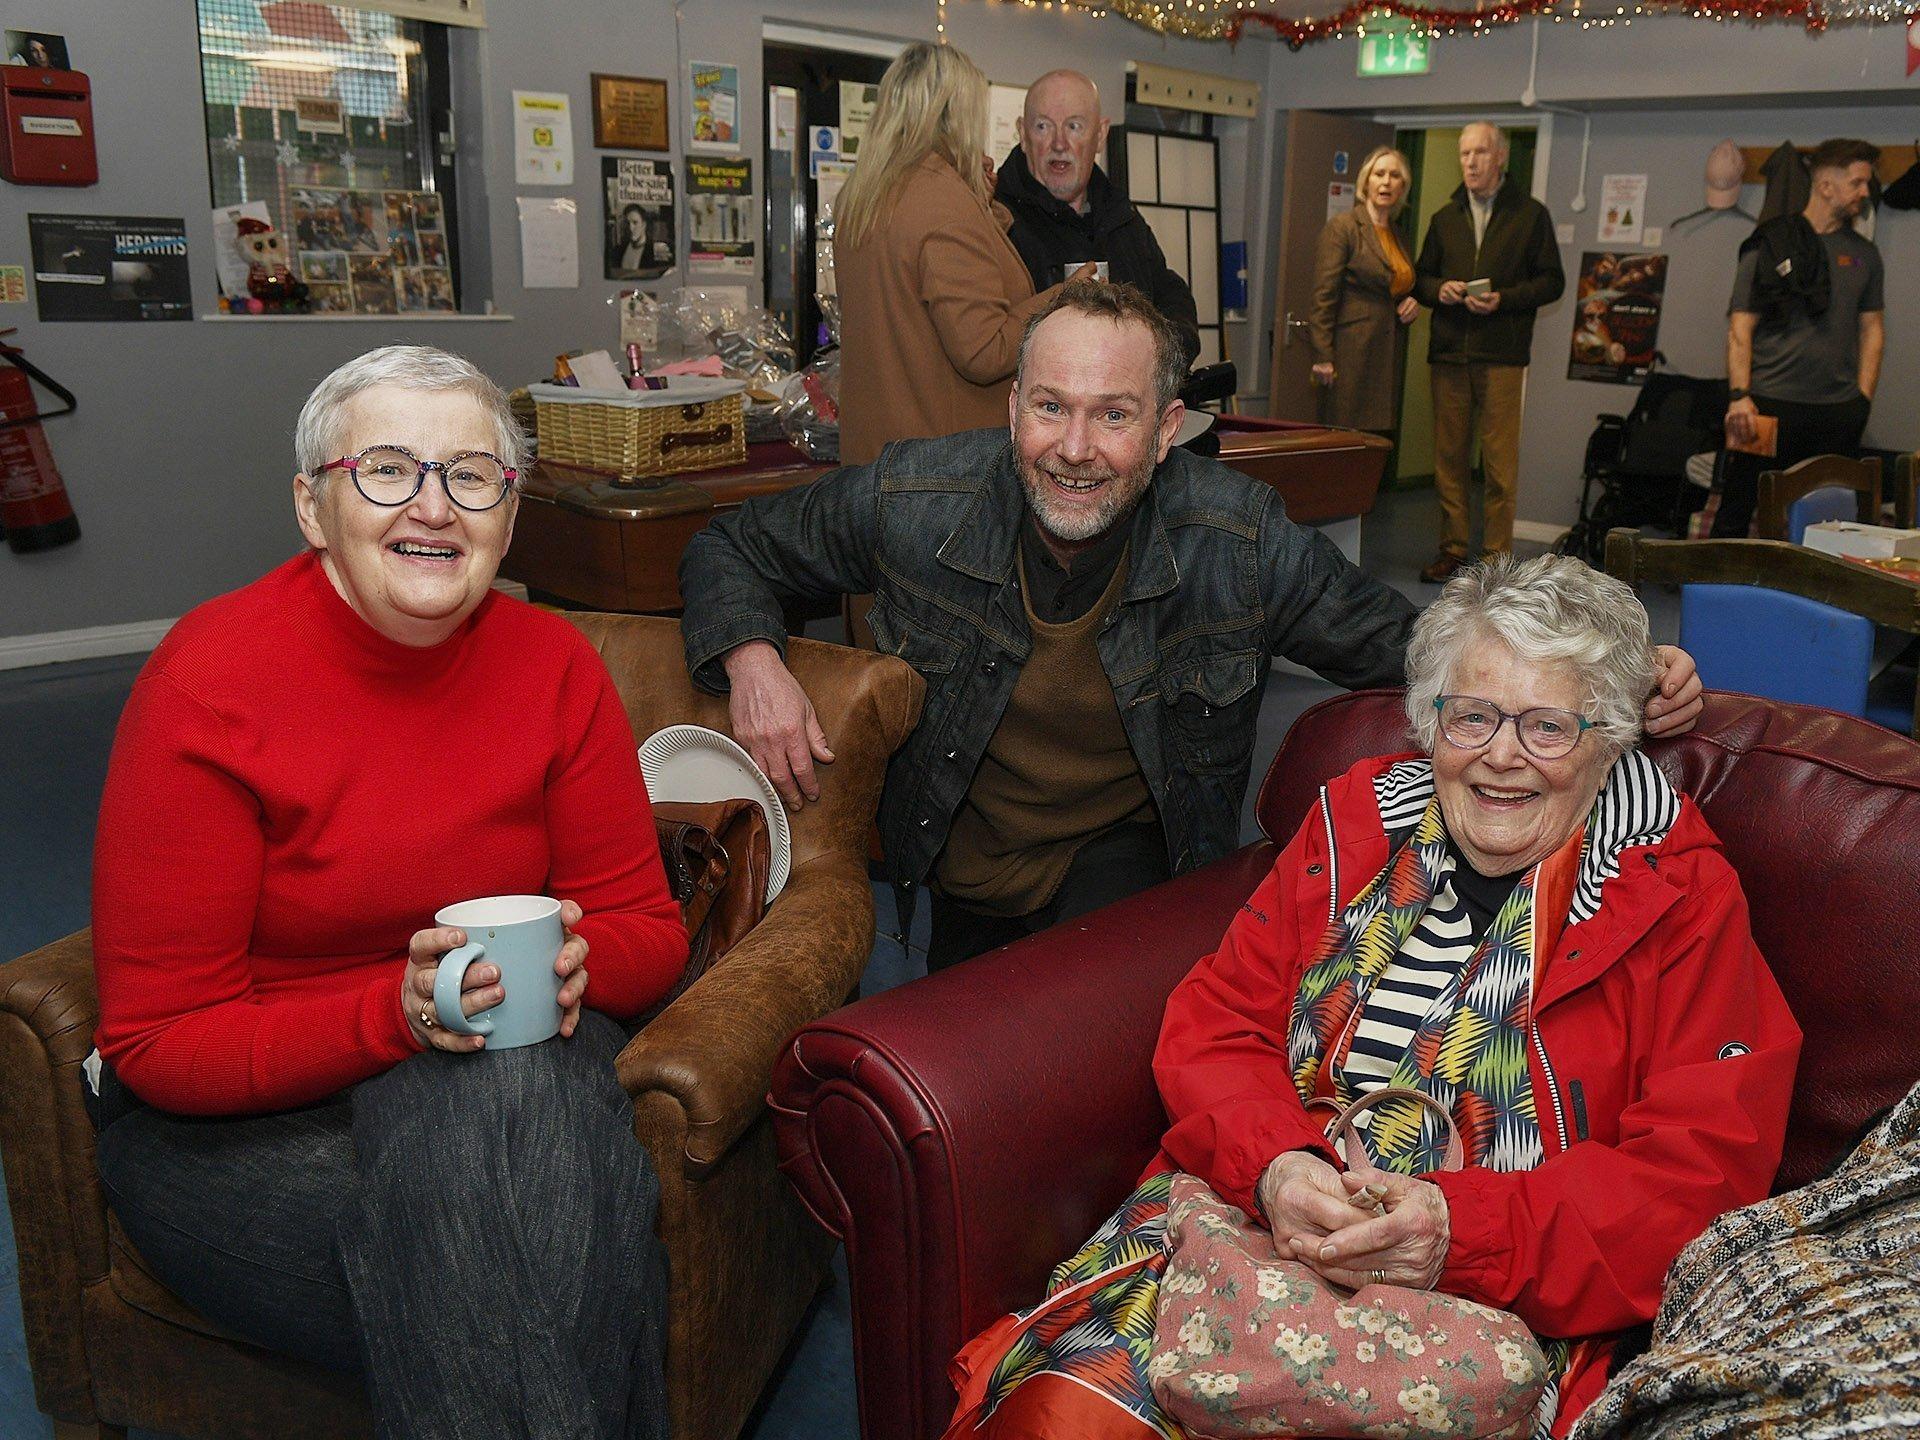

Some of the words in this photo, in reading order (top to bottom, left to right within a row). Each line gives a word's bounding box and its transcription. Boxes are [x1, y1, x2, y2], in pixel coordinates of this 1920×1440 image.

[620, 160, 652, 174] Better
[692, 164, 710, 176] The
[711, 167, 747, 178] unusual
[620, 176, 631, 187] to
[633, 176, 643, 188] be
[645, 178, 665, 190] safe
[620, 190, 643, 201] than
[115, 234, 188, 256] HEPATITIS
